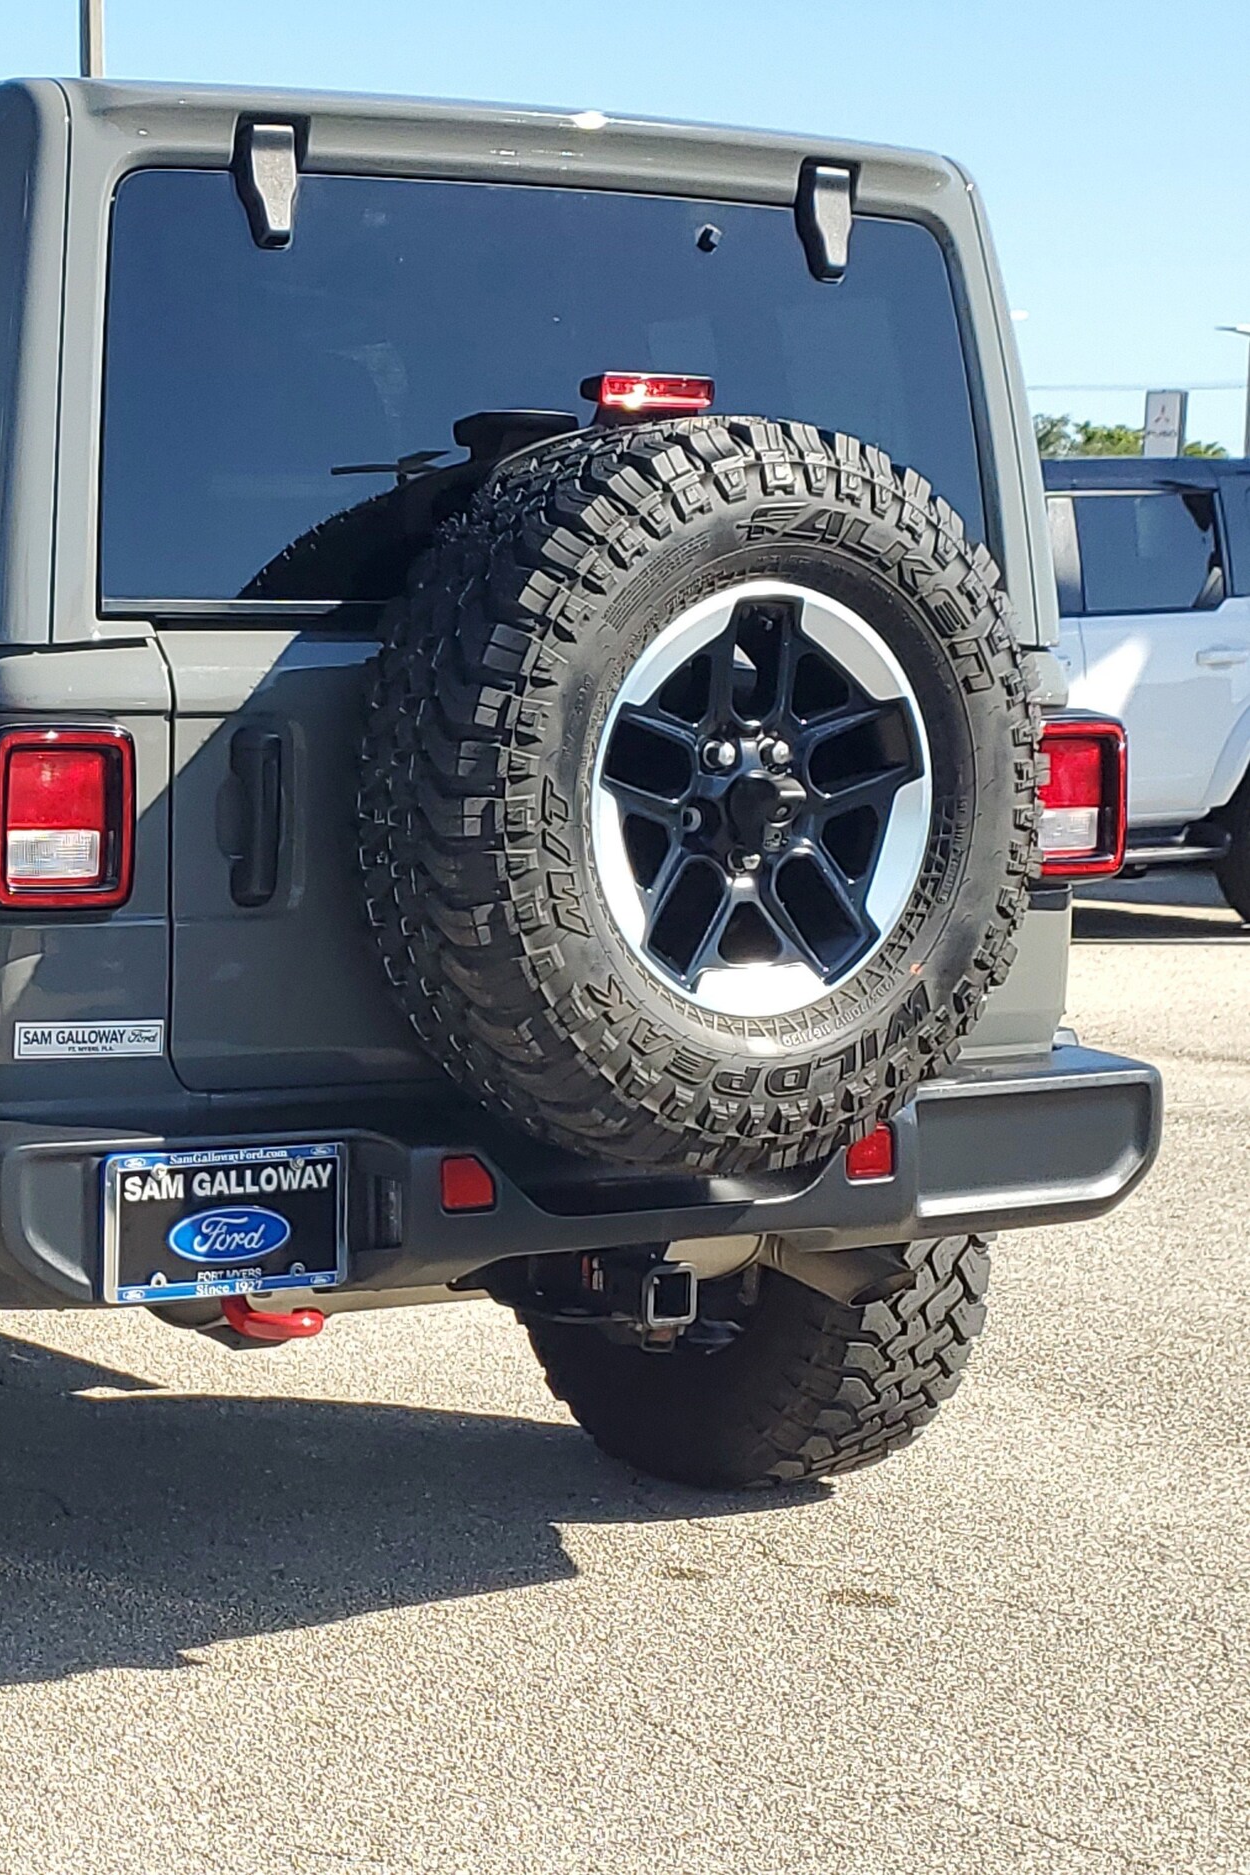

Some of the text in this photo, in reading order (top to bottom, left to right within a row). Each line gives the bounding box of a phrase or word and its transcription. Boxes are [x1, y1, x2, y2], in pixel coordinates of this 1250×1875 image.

[736, 502, 996, 694] FALKEN
[23, 1028, 158, 1045] SAM GALLOWAY Ford
[582, 974, 936, 1097] WILDPEAK
[170, 1148, 289, 1165] SamGallowayFord.com
[123, 1163, 333, 1202] SAM GALLOWAY
[193, 1216, 267, 1252] Ford
[196, 1280, 263, 1296] Since 1927
[197, 1270, 225, 1282] FORT
